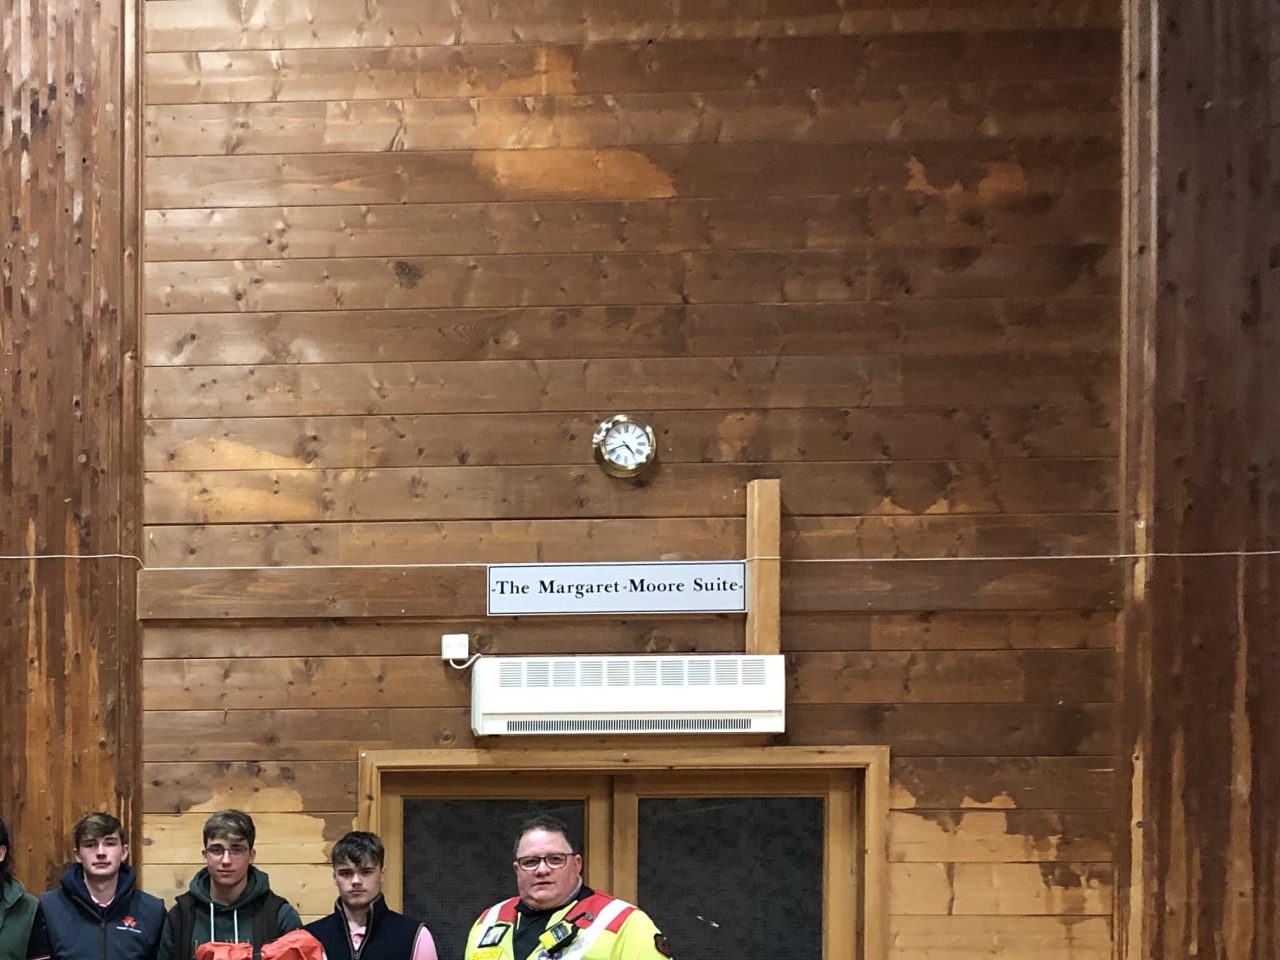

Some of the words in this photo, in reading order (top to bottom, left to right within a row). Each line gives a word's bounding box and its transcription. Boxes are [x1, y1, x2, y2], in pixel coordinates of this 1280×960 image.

[495, 579, 530, 595] The
[538, 579, 620, 599] Margaret
[628, 578, 685, 594] Moore
[693, 577, 739, 592] Suite
